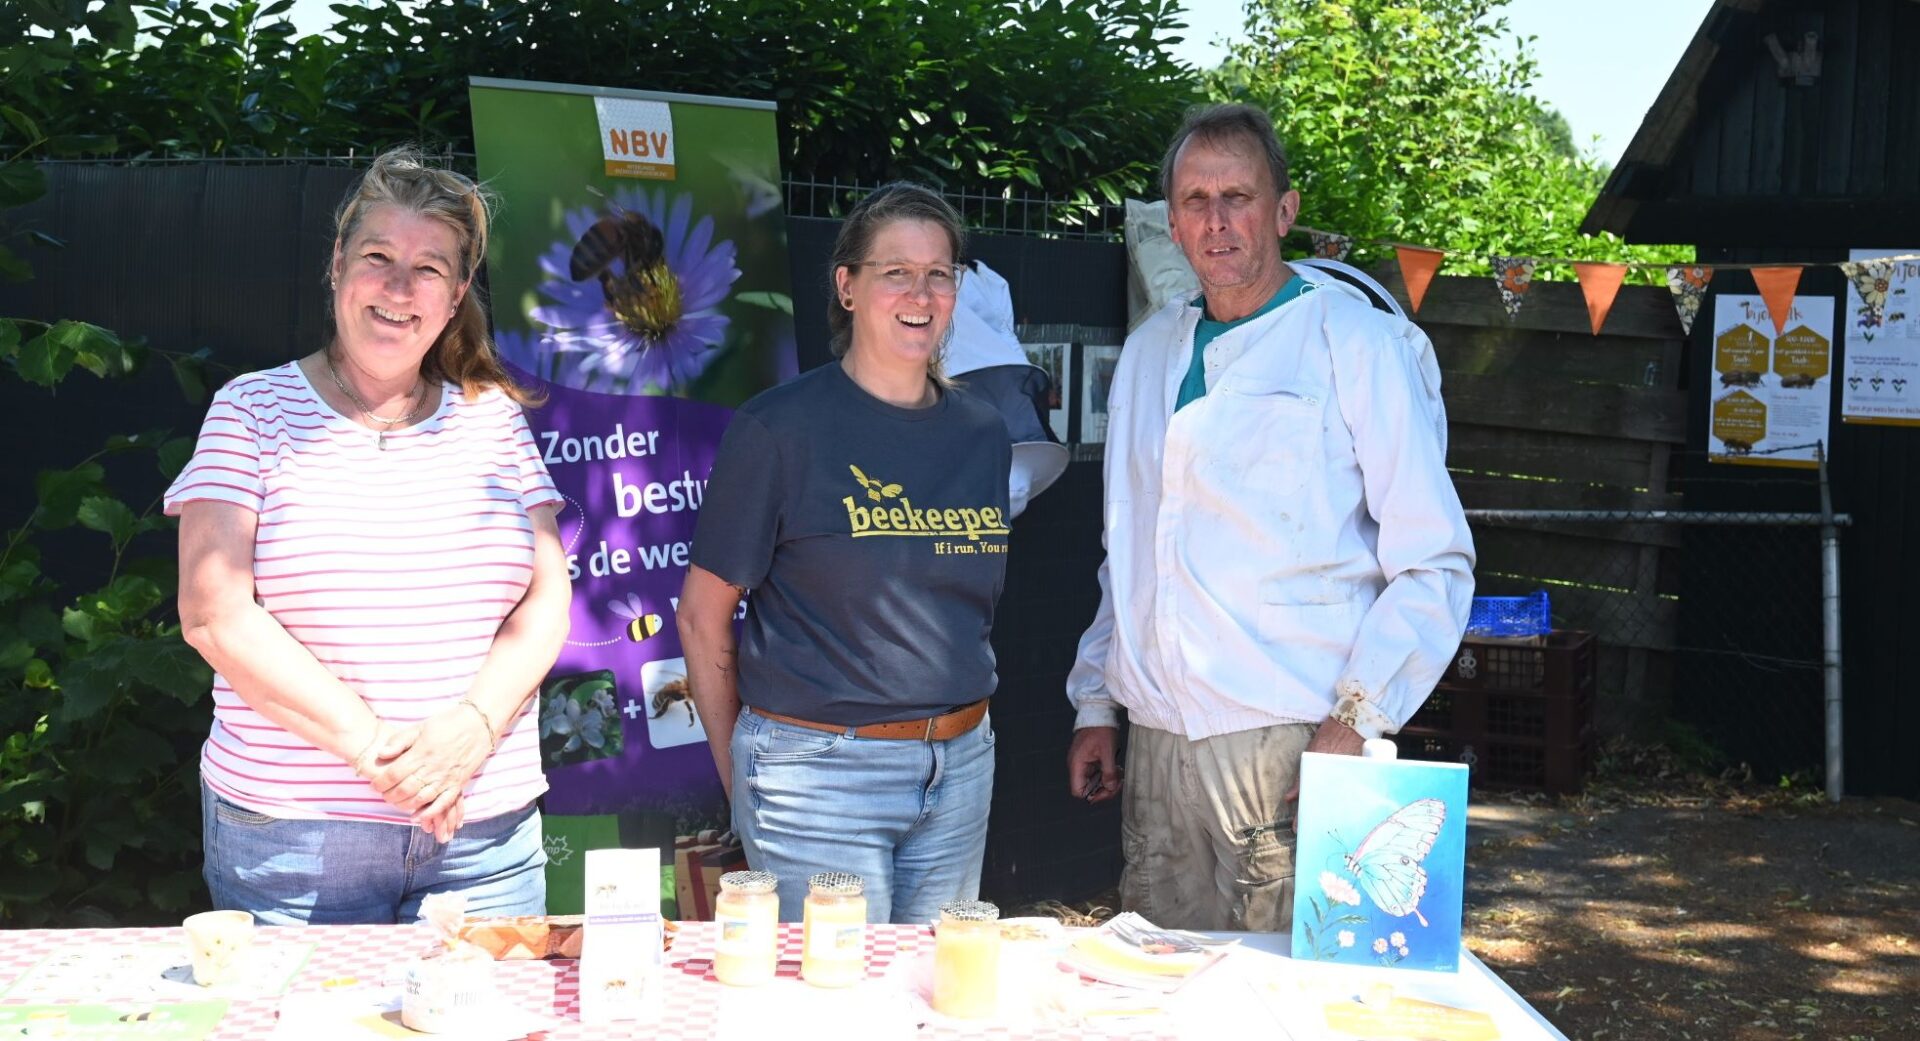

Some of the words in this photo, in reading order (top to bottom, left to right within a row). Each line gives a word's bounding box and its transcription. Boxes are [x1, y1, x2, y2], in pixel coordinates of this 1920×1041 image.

[609, 128, 668, 159] NBV
[541, 424, 660, 465] Zonder
[612, 467, 712, 519] bestu
[589, 541, 631, 577] de
[637, 542, 694, 571] we
[934, 542, 946, 555] If
[979, 542, 1000, 553] You
